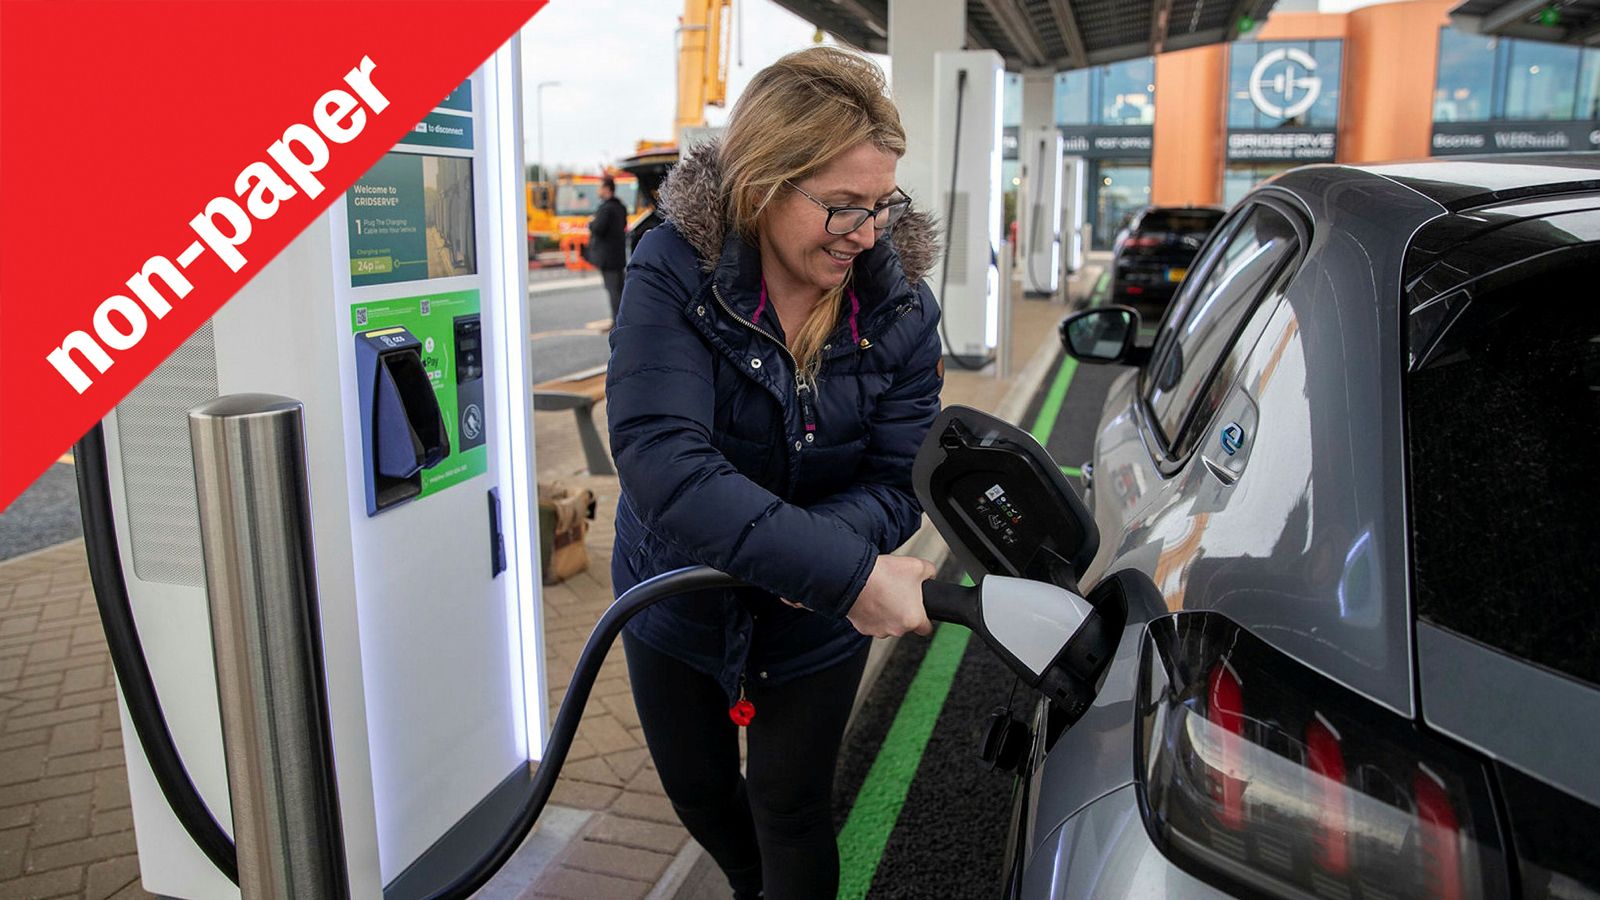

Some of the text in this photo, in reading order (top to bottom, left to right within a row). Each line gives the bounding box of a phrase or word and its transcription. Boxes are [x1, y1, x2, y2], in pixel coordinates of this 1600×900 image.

[428, 124, 435, 133] to
[435, 124, 464, 136] disconnect
[1118, 136, 1151, 149] OFFICE
[1229, 133, 1335, 148] GRIDSERVE
[353, 184, 397, 194] Welcome to
[355, 219, 362, 235] 1
[364, 218, 375, 227] Plug
[364, 227, 378, 235] Cable
[357, 260, 374, 272] 24p
[427, 357, 439, 369] Pay
